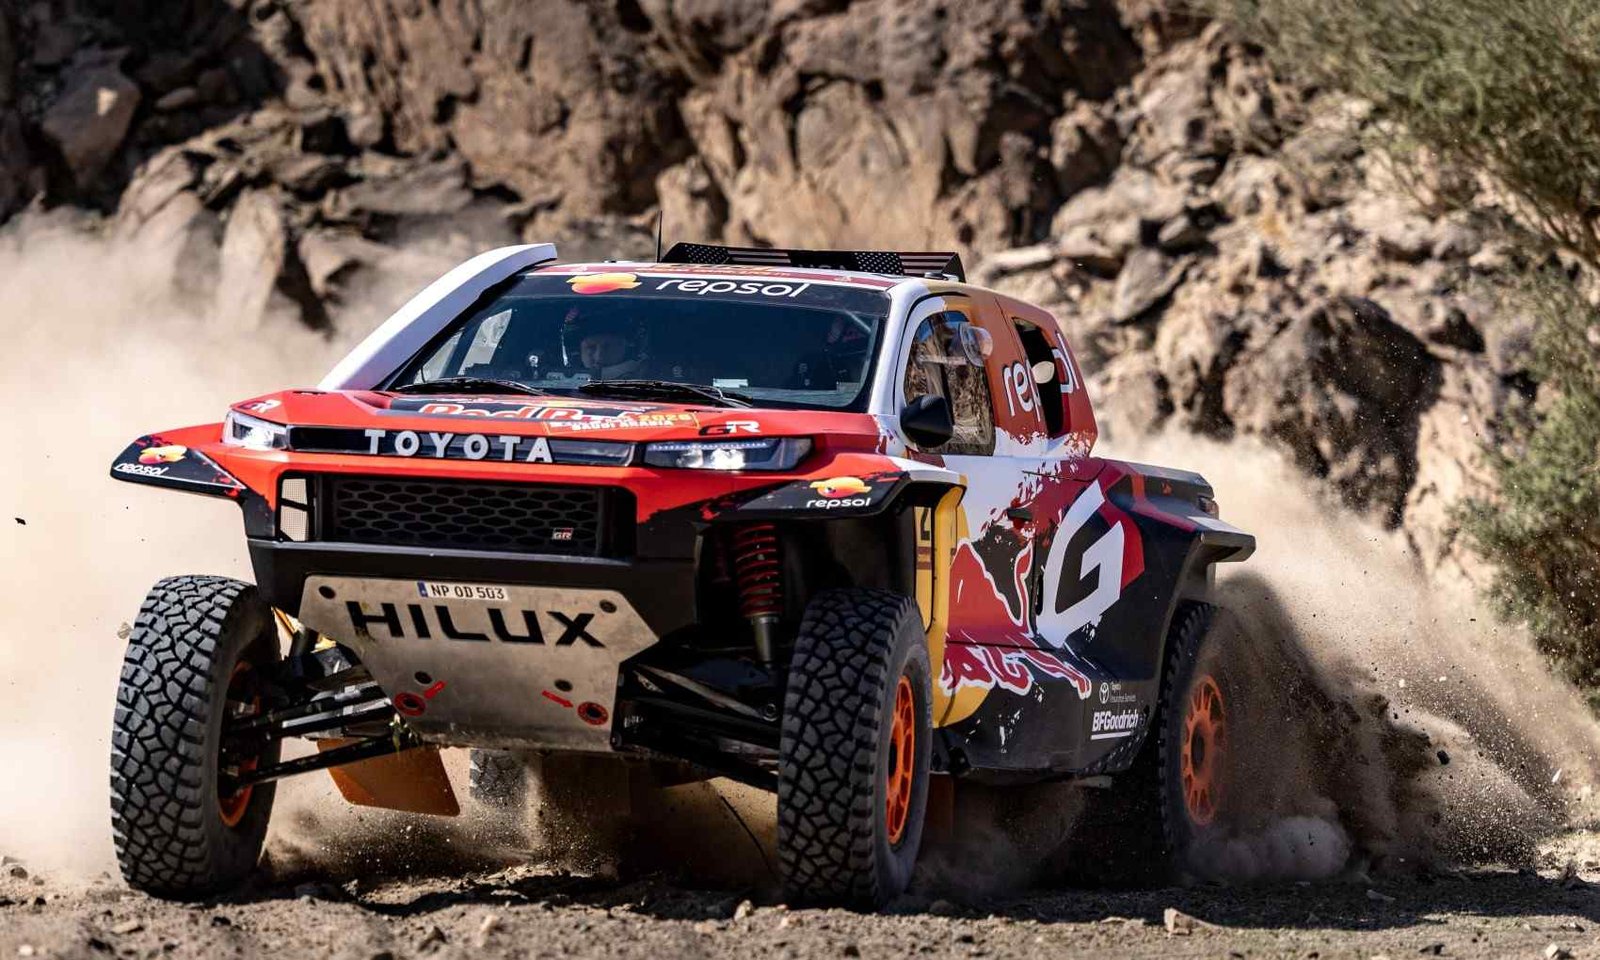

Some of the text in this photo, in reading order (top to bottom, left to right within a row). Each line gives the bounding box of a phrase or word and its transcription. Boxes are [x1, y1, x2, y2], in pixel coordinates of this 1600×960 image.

[656, 279, 811, 298] repsol
[698, 420, 760, 436] GR
[364, 429, 553, 464] TOYOTA
[806, 498, 871, 509] repsol
[431, 585, 450, 597] NP
[476, 587, 505, 600] 503
[346, 601, 606, 649] HILUX
[1091, 708, 1139, 732] BFGoodrich
